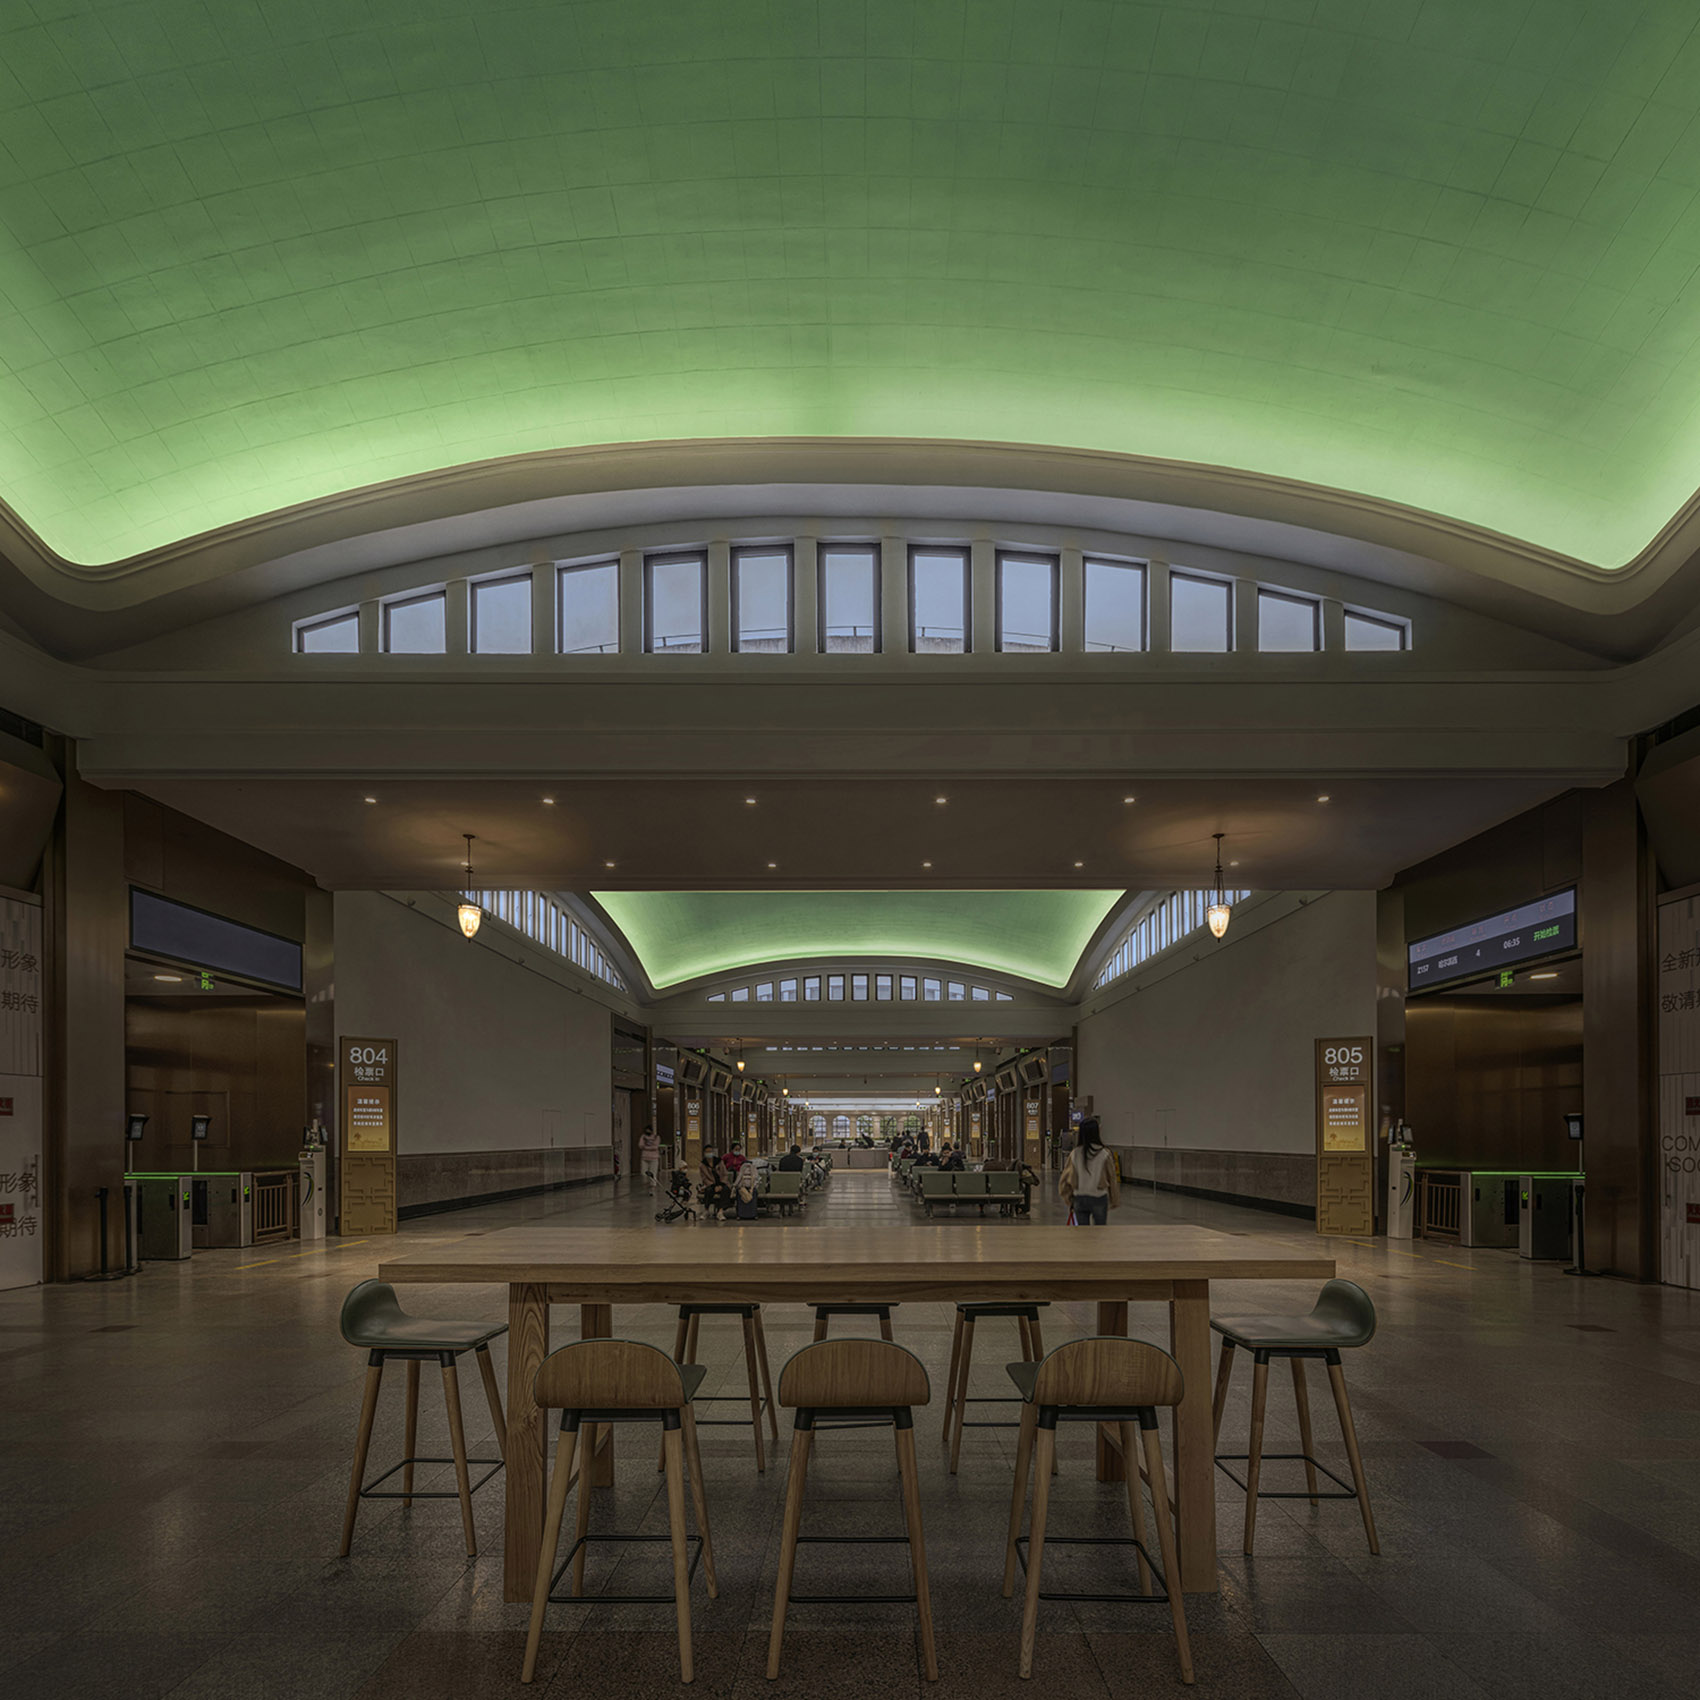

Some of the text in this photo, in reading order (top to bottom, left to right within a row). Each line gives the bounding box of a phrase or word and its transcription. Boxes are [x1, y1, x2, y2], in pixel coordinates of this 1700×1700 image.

[1, 948, 39, 973] 形象
[1662, 947, 1700, 973] 全新
[1, 990, 39, 1014] 期待
[1661, 988, 1700, 1013] 敬请
[350, 1047, 388, 1064] 804
[1325, 1047, 1363, 1064] 805
[354, 1066, 384, 1076] 检票口
[1329, 1066, 1359, 1076] 检票口
[1669, 1156, 1700, 1174] SO
